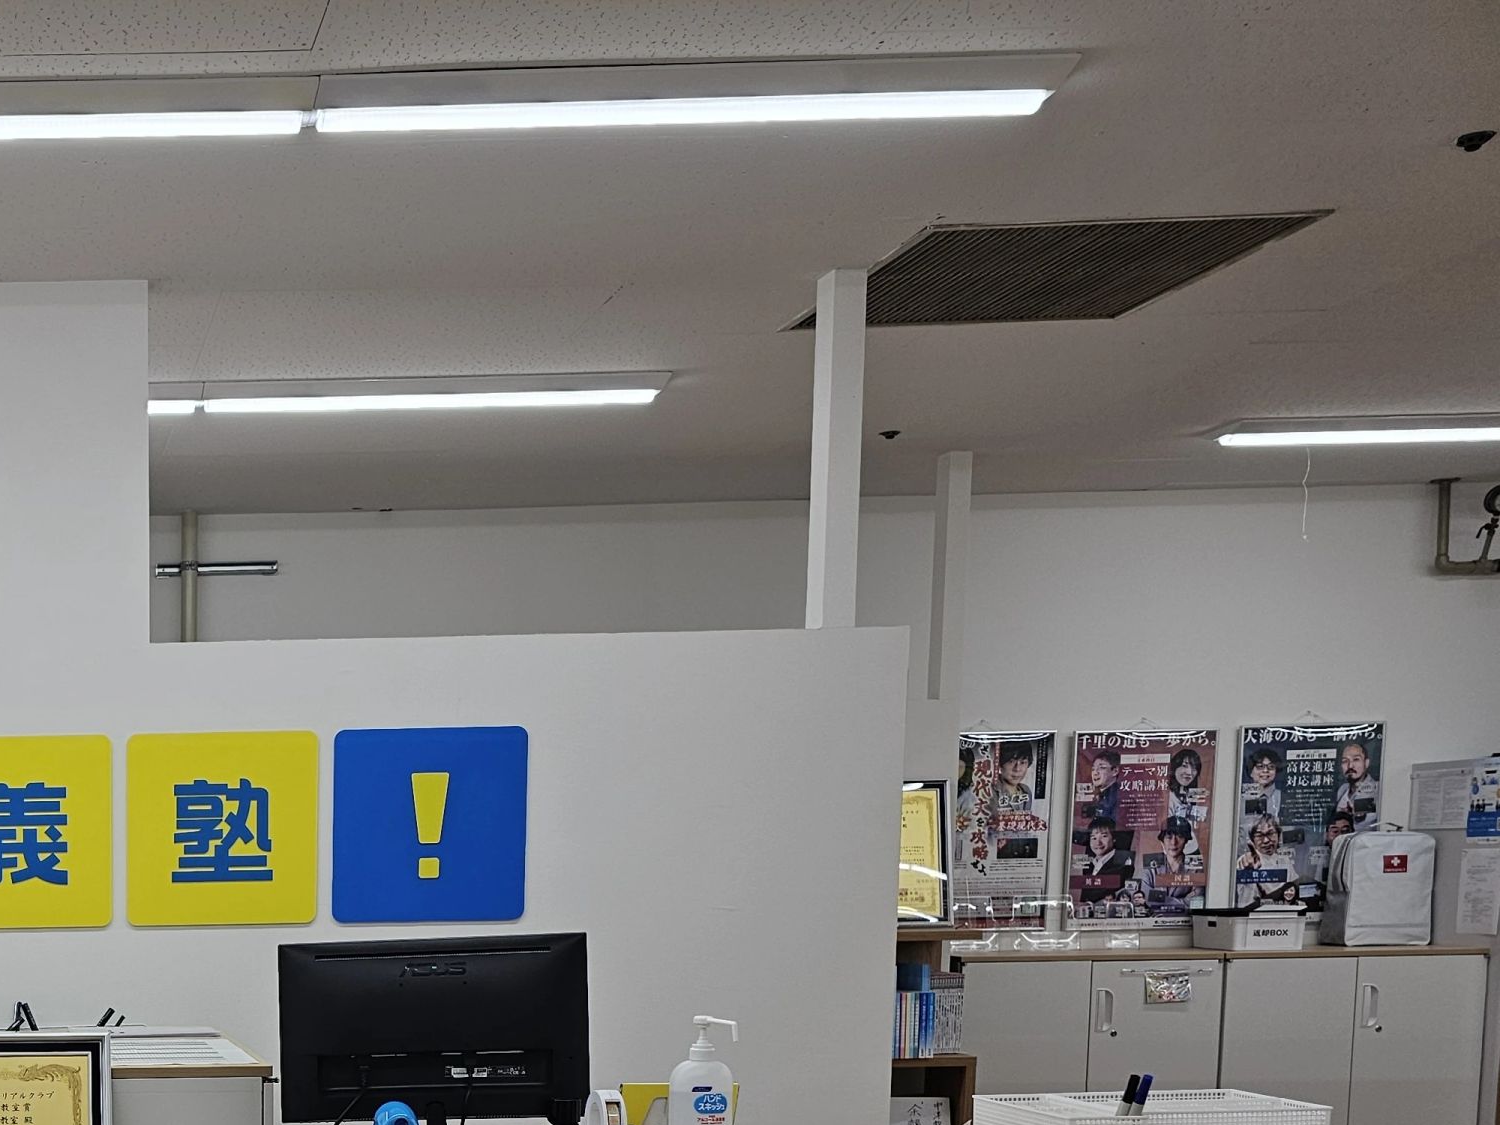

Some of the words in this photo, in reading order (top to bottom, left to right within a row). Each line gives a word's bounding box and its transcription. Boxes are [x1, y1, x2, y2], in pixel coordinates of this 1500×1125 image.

[1122, 765, 1169, 777] テーマ別
[1286, 759, 1336, 773] 高校進度
[1120, 779, 1169, 791] 攻略講座
[1286, 774, 1335, 787] 対応講座
[399, 961, 467, 977] ASUS
[703, 1094, 722, 1102] ハンド
[698, 1102, 725, 1111] スキッシュ
